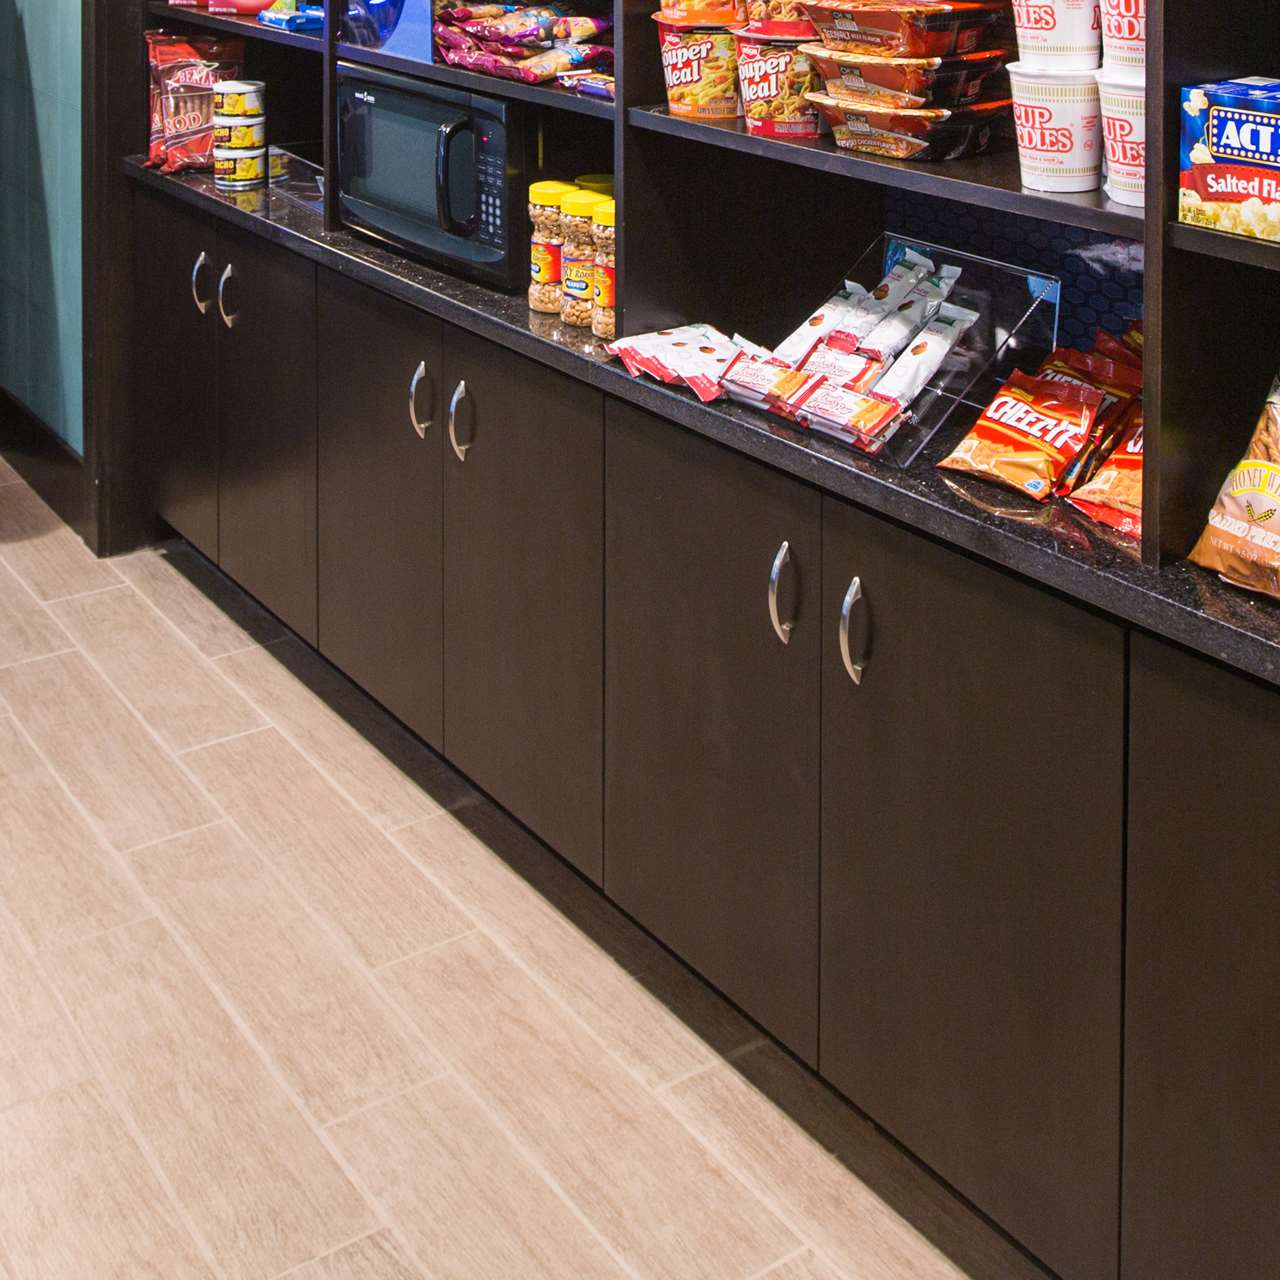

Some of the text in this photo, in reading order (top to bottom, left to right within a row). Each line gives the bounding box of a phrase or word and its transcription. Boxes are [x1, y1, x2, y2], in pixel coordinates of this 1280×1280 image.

[662, 40, 713, 66] ouper
[739, 53, 793, 80] ouper
[1220, 120, 1275, 153] ACT
[1206, 174, 1260, 197] Salted
[1231, 468, 1266, 492] HONEY
